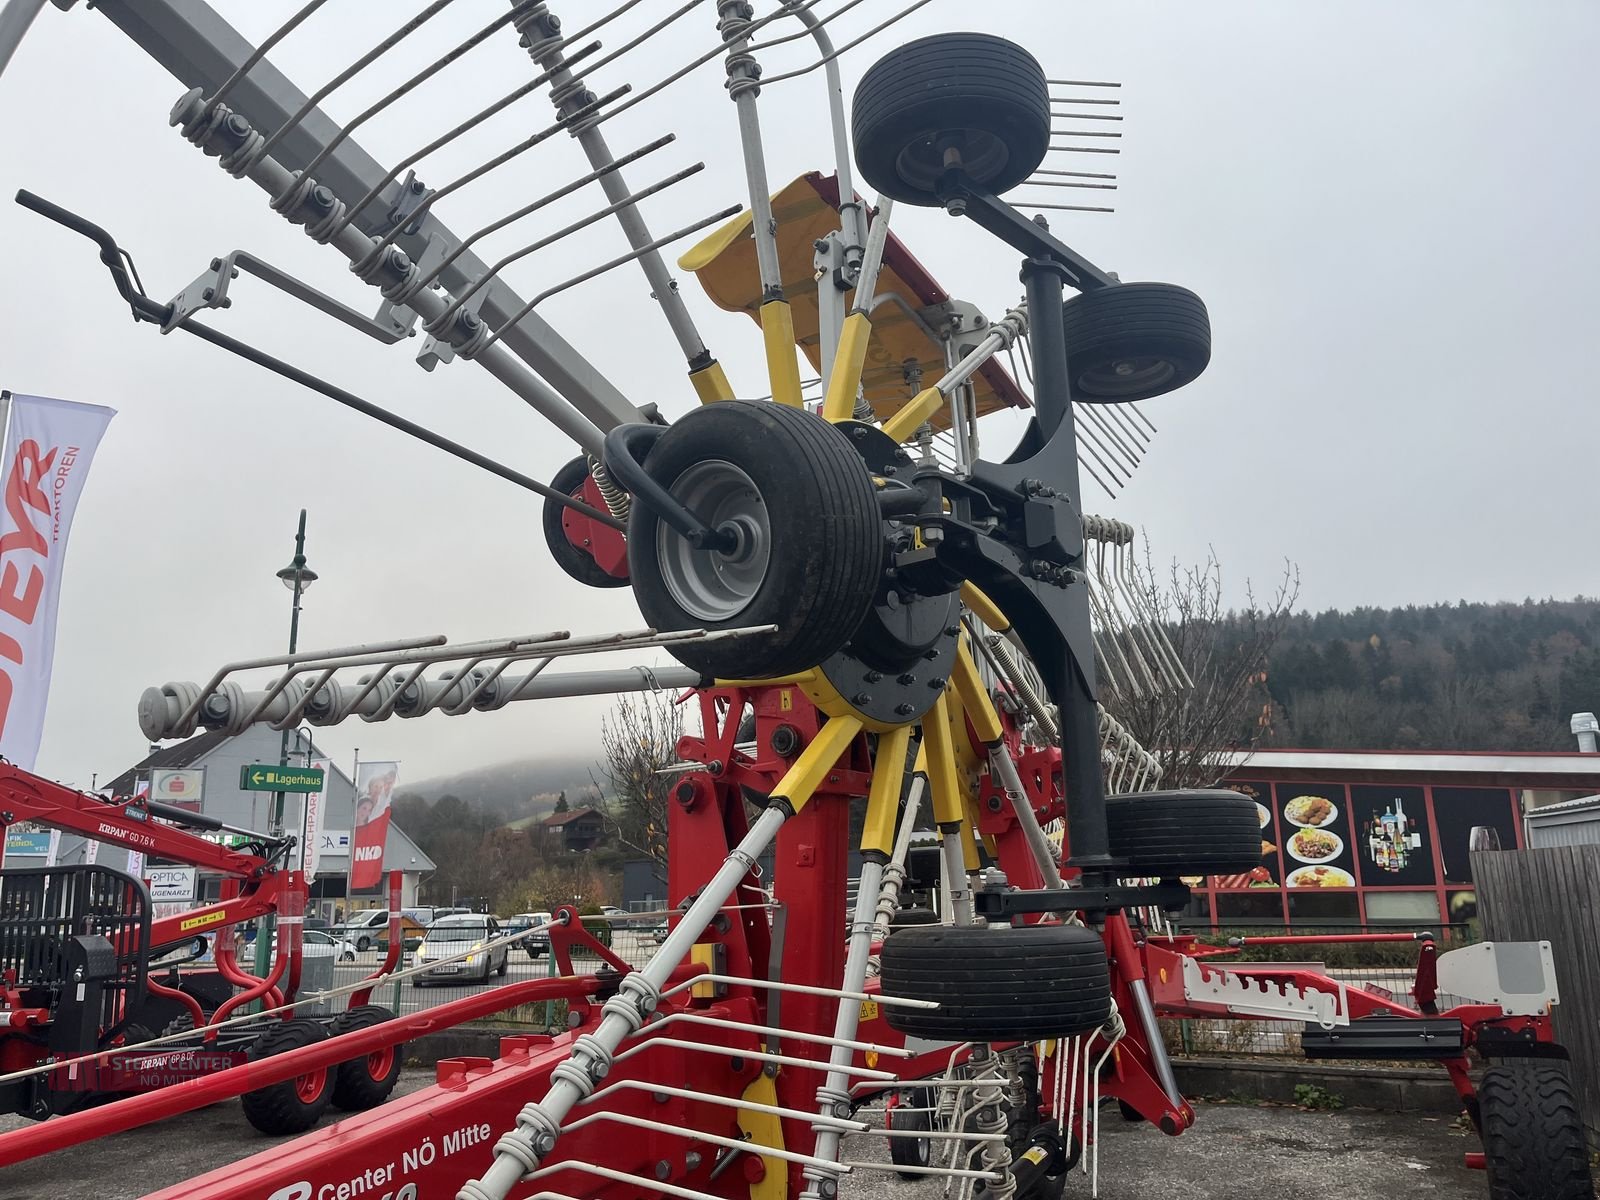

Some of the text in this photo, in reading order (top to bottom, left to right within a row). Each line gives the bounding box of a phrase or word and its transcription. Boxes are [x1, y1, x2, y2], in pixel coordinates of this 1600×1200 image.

[53, 446, 80, 543] TRAKTOREN
[276, 773, 321, 786] Lagerhaus
[99, 823, 127, 838] KRPAN
[129, 832, 140, 843] GD
[149, 838, 156, 847] K
[355, 846, 382, 861] NKD
[150, 872, 188, 882] OPTICA
[140, 1057, 168, 1071] KRPAN
[180, 1053, 187, 1062] 8
[317, 1162, 395, 1200] Center
[402, 1136, 436, 1174] NÖ
[443, 1122, 491, 1157] Mitte
